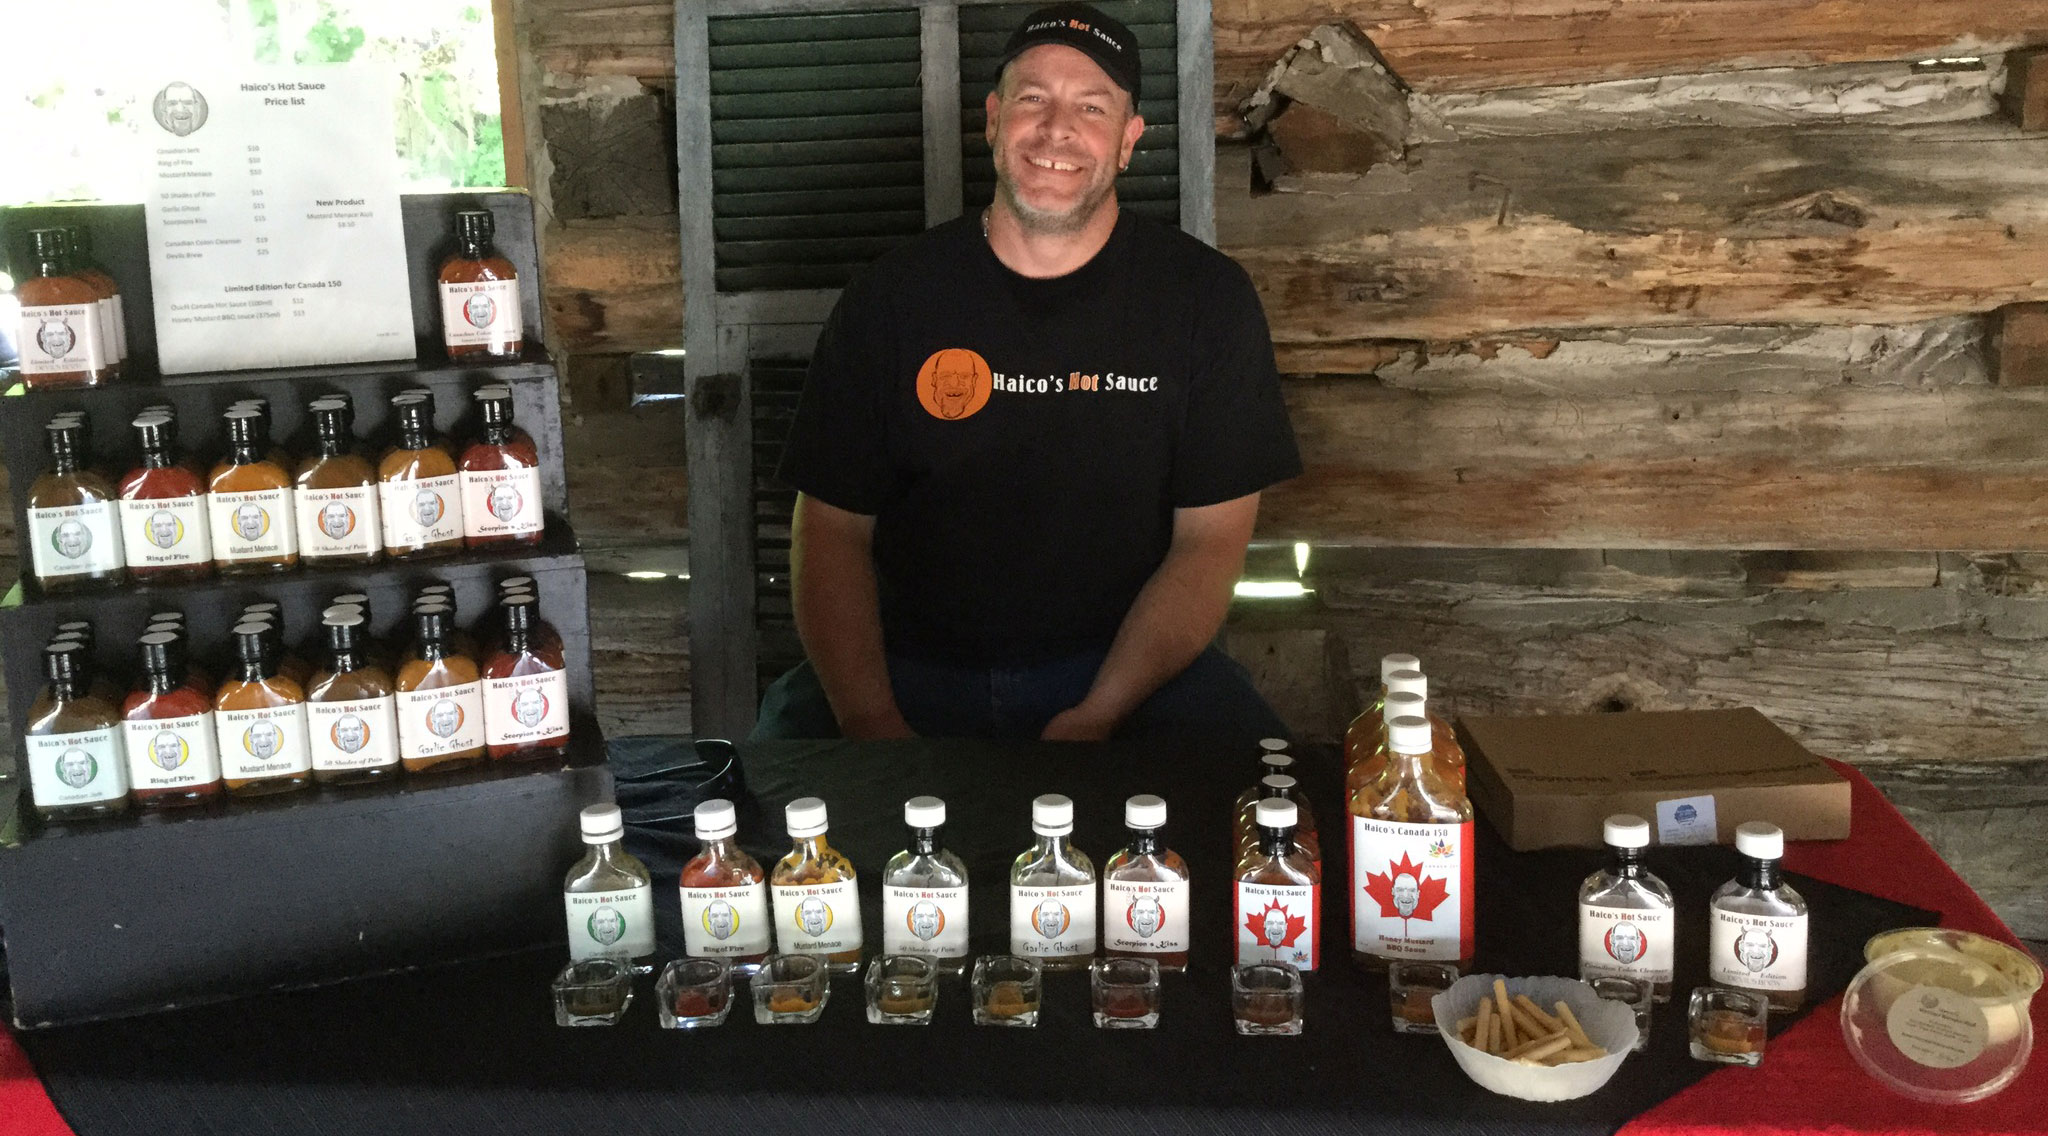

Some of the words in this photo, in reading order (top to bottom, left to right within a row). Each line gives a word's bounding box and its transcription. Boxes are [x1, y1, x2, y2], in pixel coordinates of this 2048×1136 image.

[1069, 19, 1090, 31] Hot
[1093, 28, 1122, 52] Sauce
[241, 83, 276, 91] Haico's
[291, 97, 305, 105] list
[316, 199, 333, 207] New
[336, 198, 365, 206] Product
[224, 284, 253, 292] Limited
[256, 283, 283, 291] Edition
[285, 282, 296, 290] for
[297, 281, 326, 289] Canada
[993, 372, 1063, 393] Haico's
[1068, 372, 1099, 392] Hot
[1105, 372, 1158, 392] Sauce
[435, 479, 454, 487] Sauce
[259, 493, 280, 501] Sauce
[172, 500, 194, 508] Sauce
[535, 675, 556, 684] Sauce
[454, 687, 475, 696] Sauce
[273, 710, 296, 718] Sauce
[160, 722, 174, 730] Hot
[176, 720, 199, 728] Sauce
[84, 735, 108, 743] Sauce
[240, 765, 266, 773] Mustard
[266, 762, 292, 771] Menace
[1364, 823, 1395, 834] Haico's
[1398, 827, 1430, 837] Canada
[1434, 829, 1448, 837] 150
[780, 889, 805, 897] Haico's
[821, 886, 843, 895] Sauce
[1110, 884, 1136, 892] Haico's
[1245, 887, 1270, 895] Haico's
[615, 894, 636, 902] Sauce
[729, 890, 750, 898] Sauce
[894, 890, 919, 898] Haico's
[1018, 890, 1044, 898] Haico's
[1062, 889, 1082, 897] Sauce
[1590, 910, 1618, 919] Haico's
[1720, 913, 1750, 926] Haico's
[1753, 919, 1767, 927] Hot
[1770, 920, 1793, 928] Sauce
[794, 942, 817, 950] Mustard
[818, 941, 842, 949] Menace
[1386, 944, 1402, 952] BBQ
